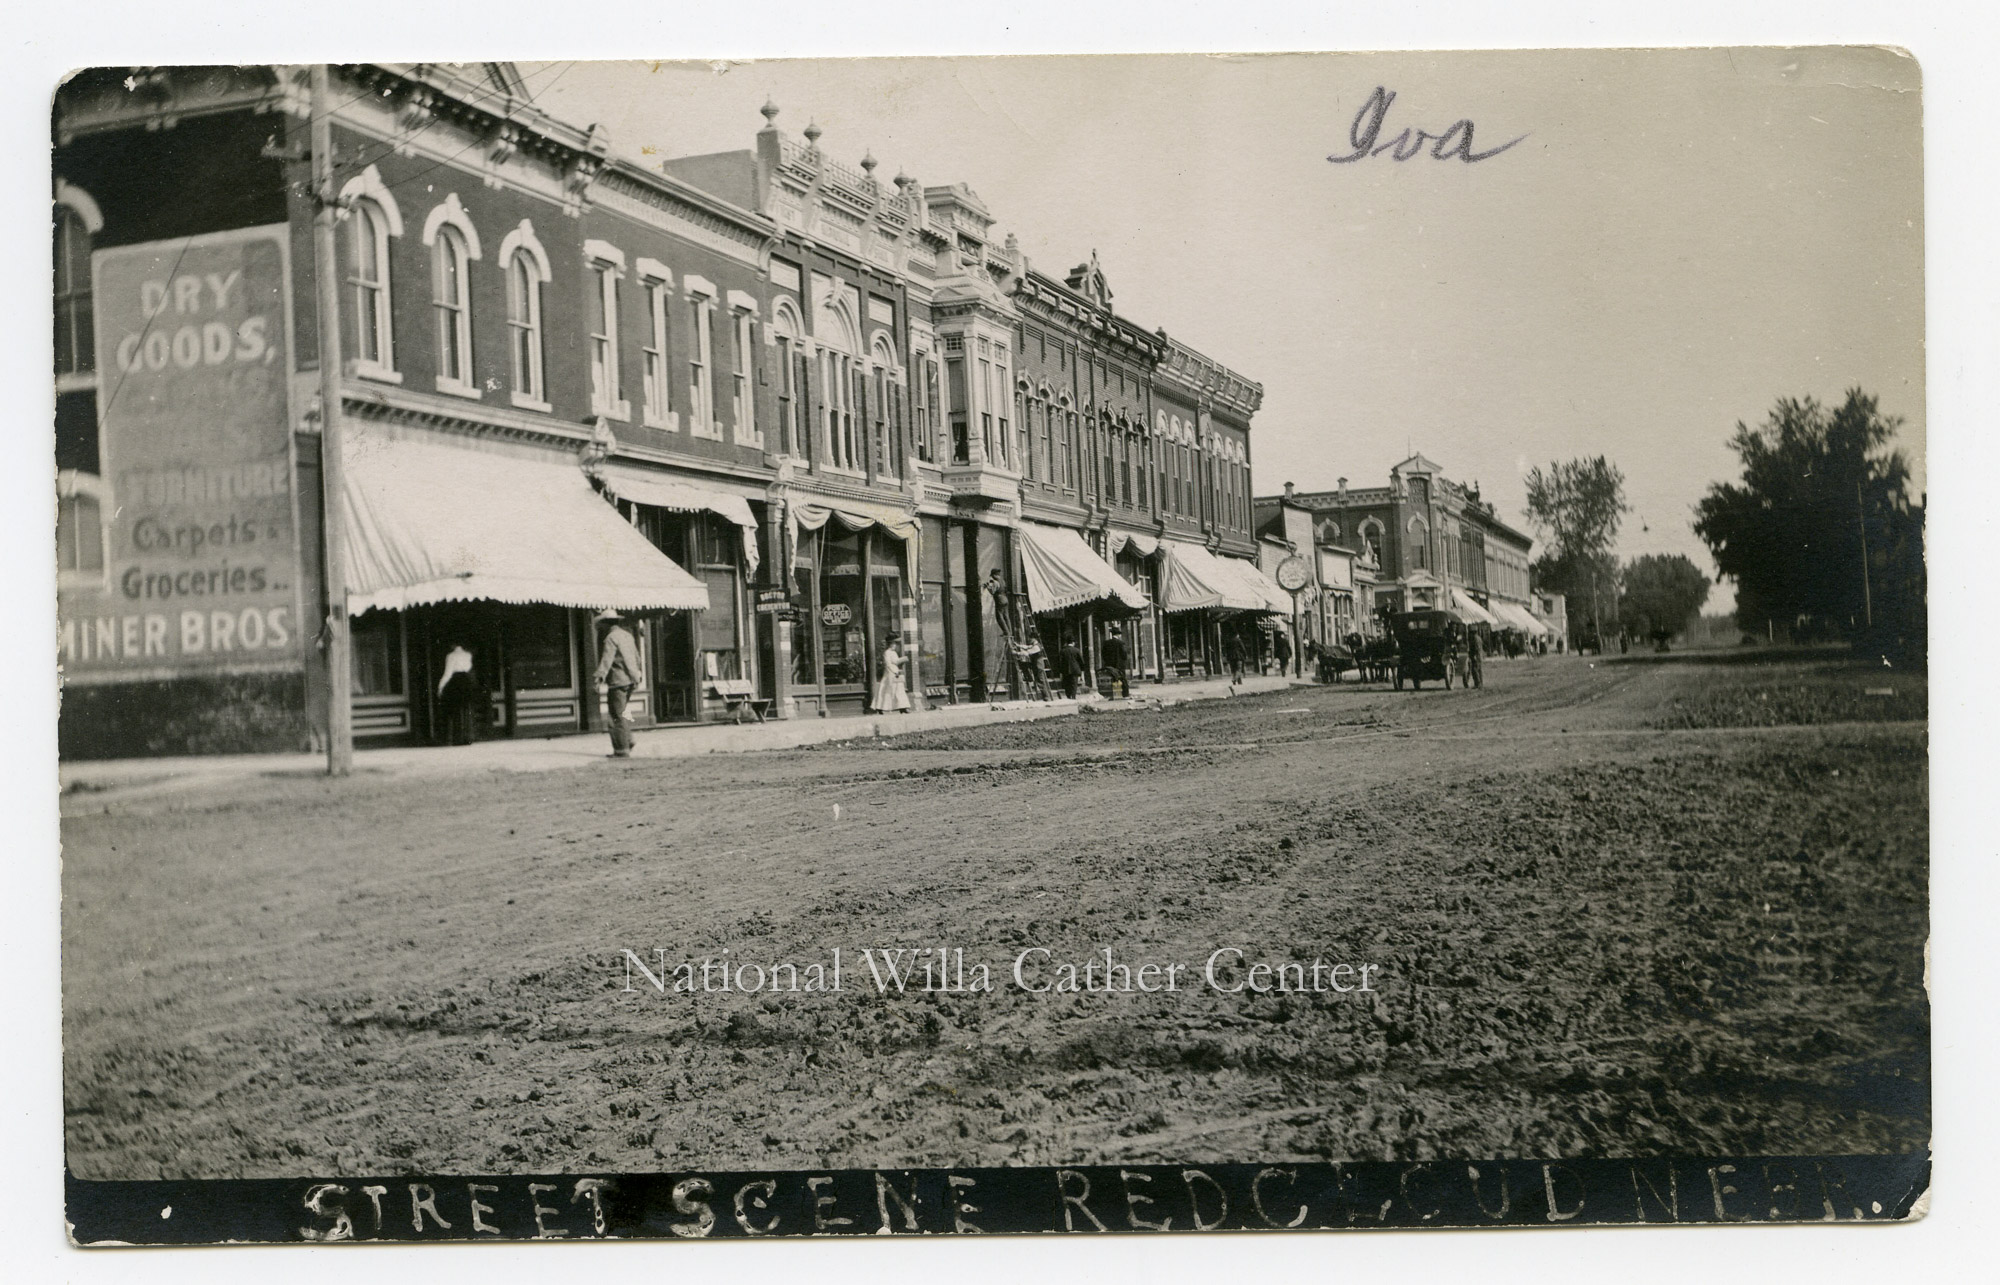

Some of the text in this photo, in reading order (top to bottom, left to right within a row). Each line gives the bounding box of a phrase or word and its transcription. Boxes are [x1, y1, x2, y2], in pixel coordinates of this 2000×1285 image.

[140, 270, 241, 319] DRY
[116, 316, 276, 374] GOODS,
[131, 514, 257, 557] Carpets
[180, 606, 289, 654] BROS
